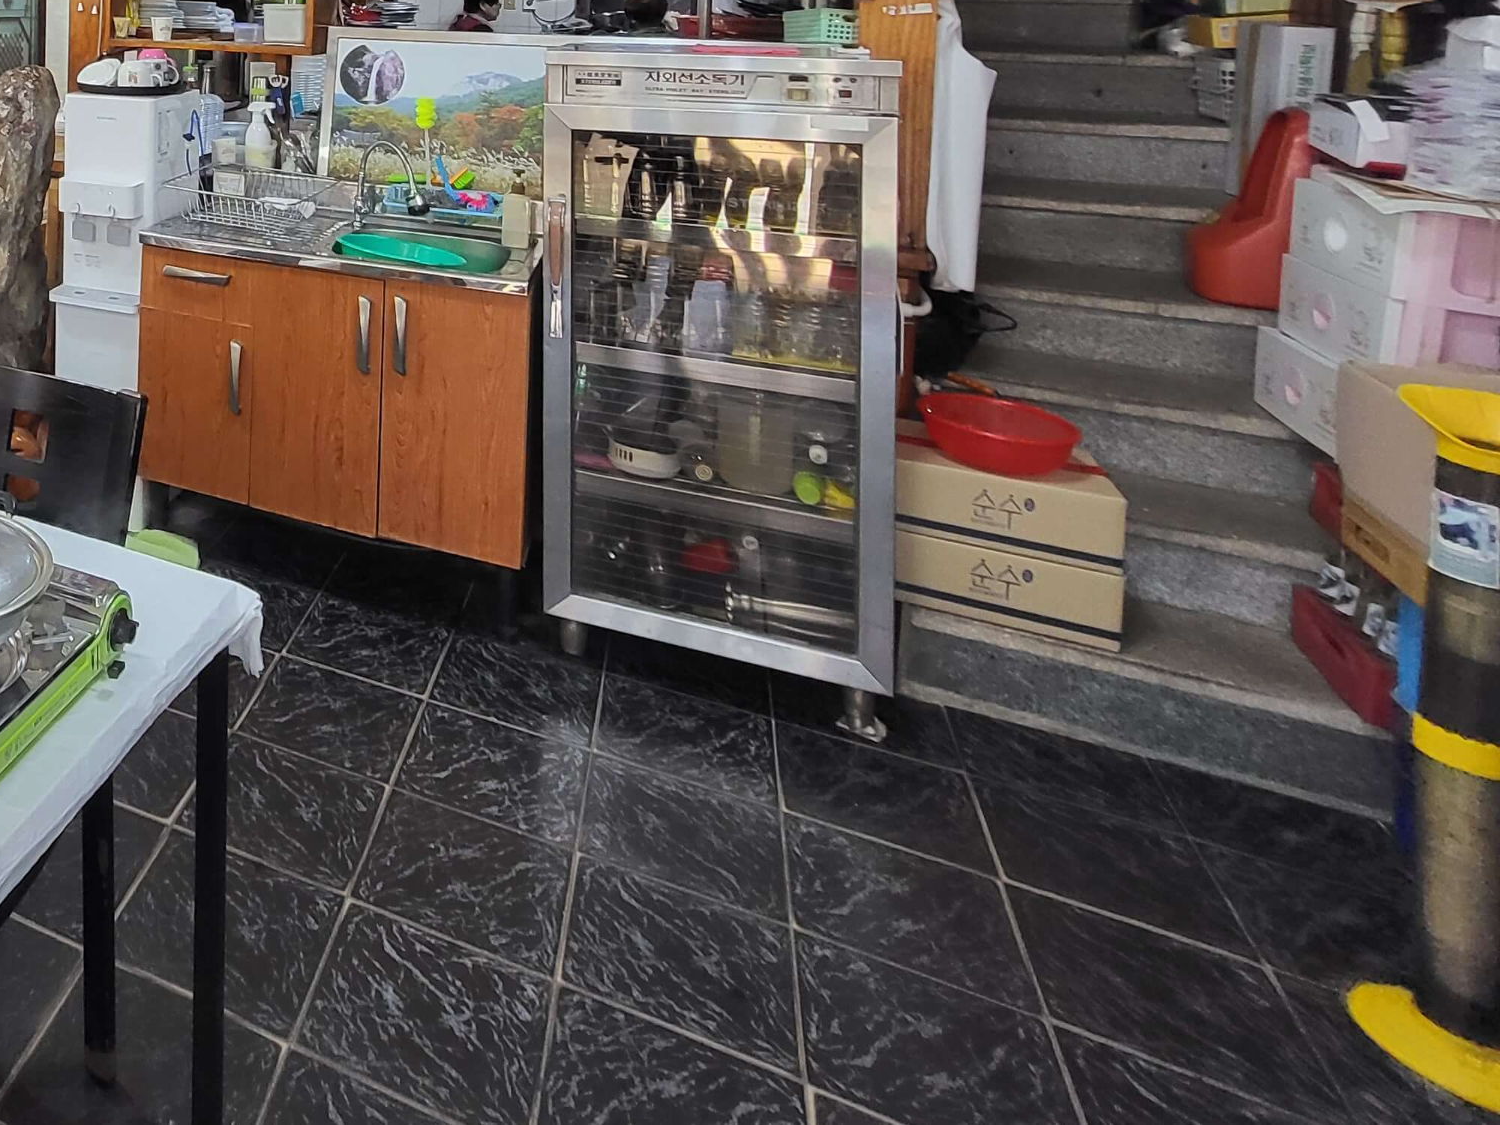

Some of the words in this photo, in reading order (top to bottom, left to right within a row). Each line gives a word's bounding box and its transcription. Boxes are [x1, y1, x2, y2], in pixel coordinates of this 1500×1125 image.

[644, 70, 745, 86] 자외선소독기
[970, 488, 1023, 530] 순수
[969, 558, 1021, 601] 순수
